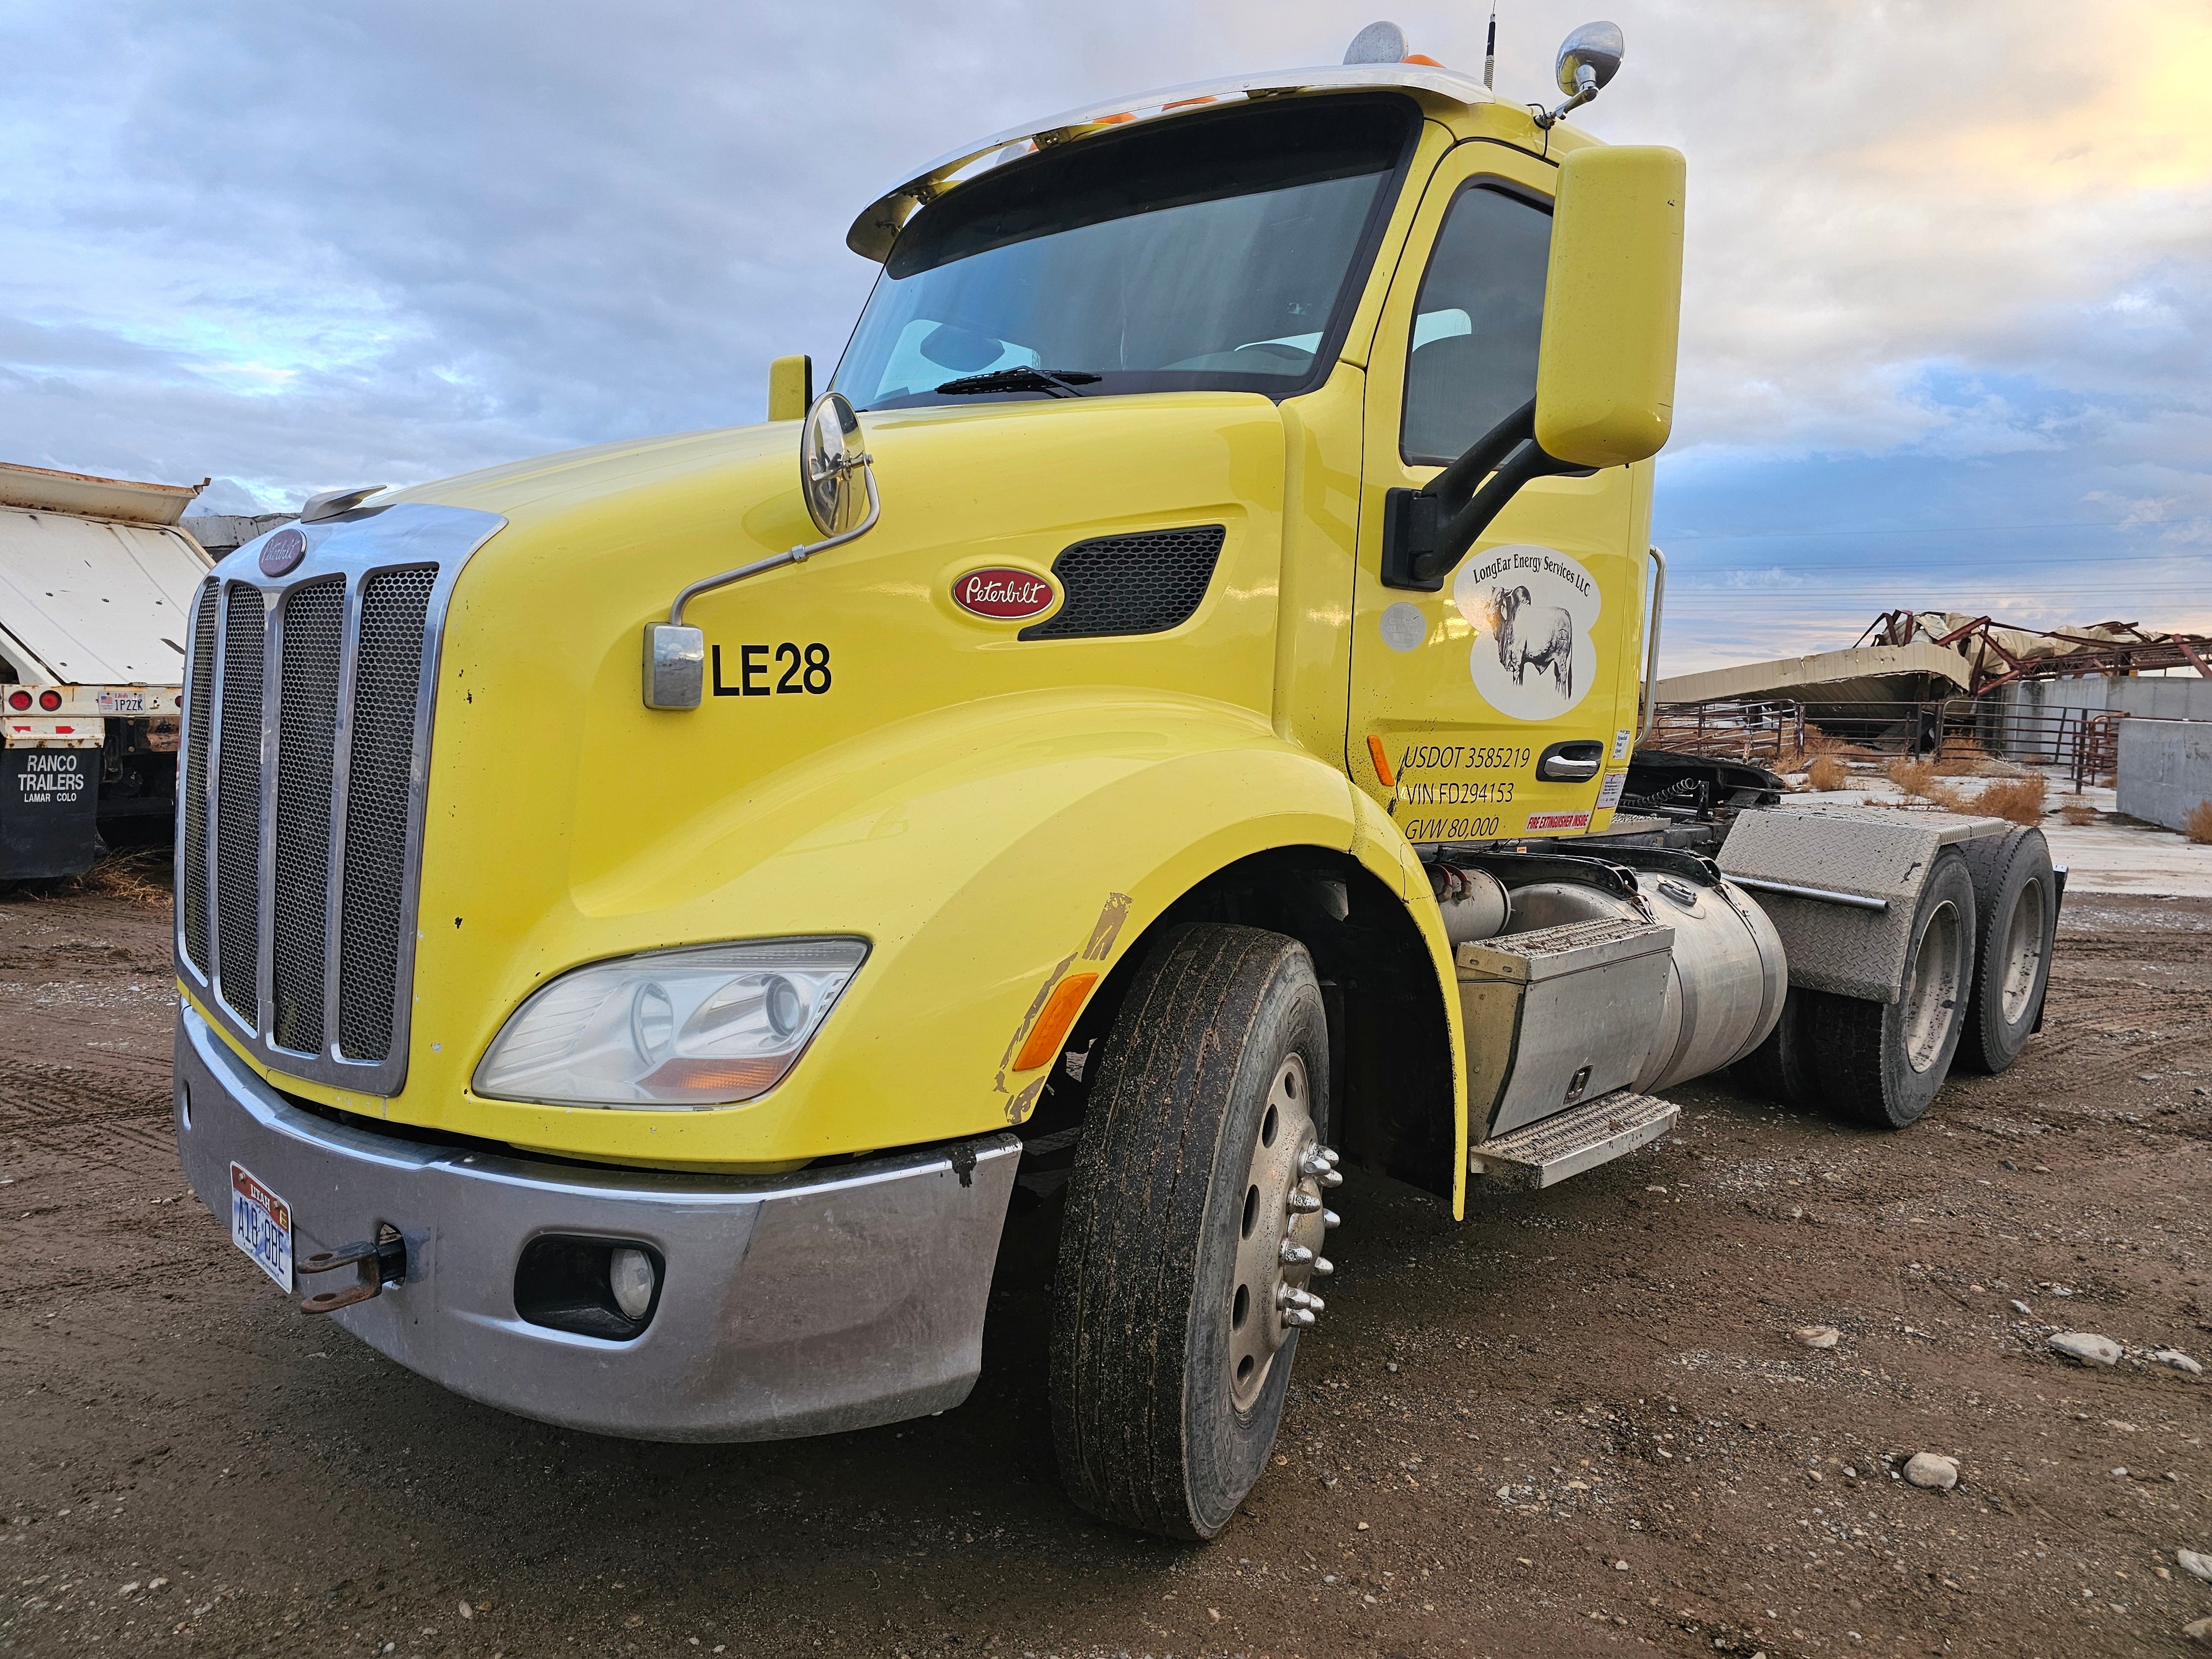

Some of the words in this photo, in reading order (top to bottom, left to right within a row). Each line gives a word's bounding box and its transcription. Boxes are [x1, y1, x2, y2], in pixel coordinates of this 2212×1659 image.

[1473, 556, 1512, 584] LongEar
[1513, 554, 1542, 573] Energy
[1544, 556, 1575, 584] Services
[1575, 574, 1590, 597] LLC
[965, 577, 1046, 604] Peterbilt
[711, 642, 832, 696] LE28
[115, 699, 143, 711] 1P2ZK
[27, 755, 77, 771] RANCO
[1404, 746, 1465, 768] USDOT
[1465, 747, 1531, 768] 3585219
[18, 774, 84, 791] TRAILERS
[24, 793, 51, 802] LAMAR
[56, 793, 77, 802] COLO
[1406, 783, 1434, 805] VIN
[1439, 783, 1514, 804] FD294153
[1405, 818, 1448, 840] GVW
[1448, 817, 1499, 840] 80,000
[1527, 816, 1541, 830] FIRE
[1539, 815, 1573, 829] EXTINGUISHER
[1571, 814, 1589, 827] INSIDE
[250, 1183, 271, 1213] UTAH
